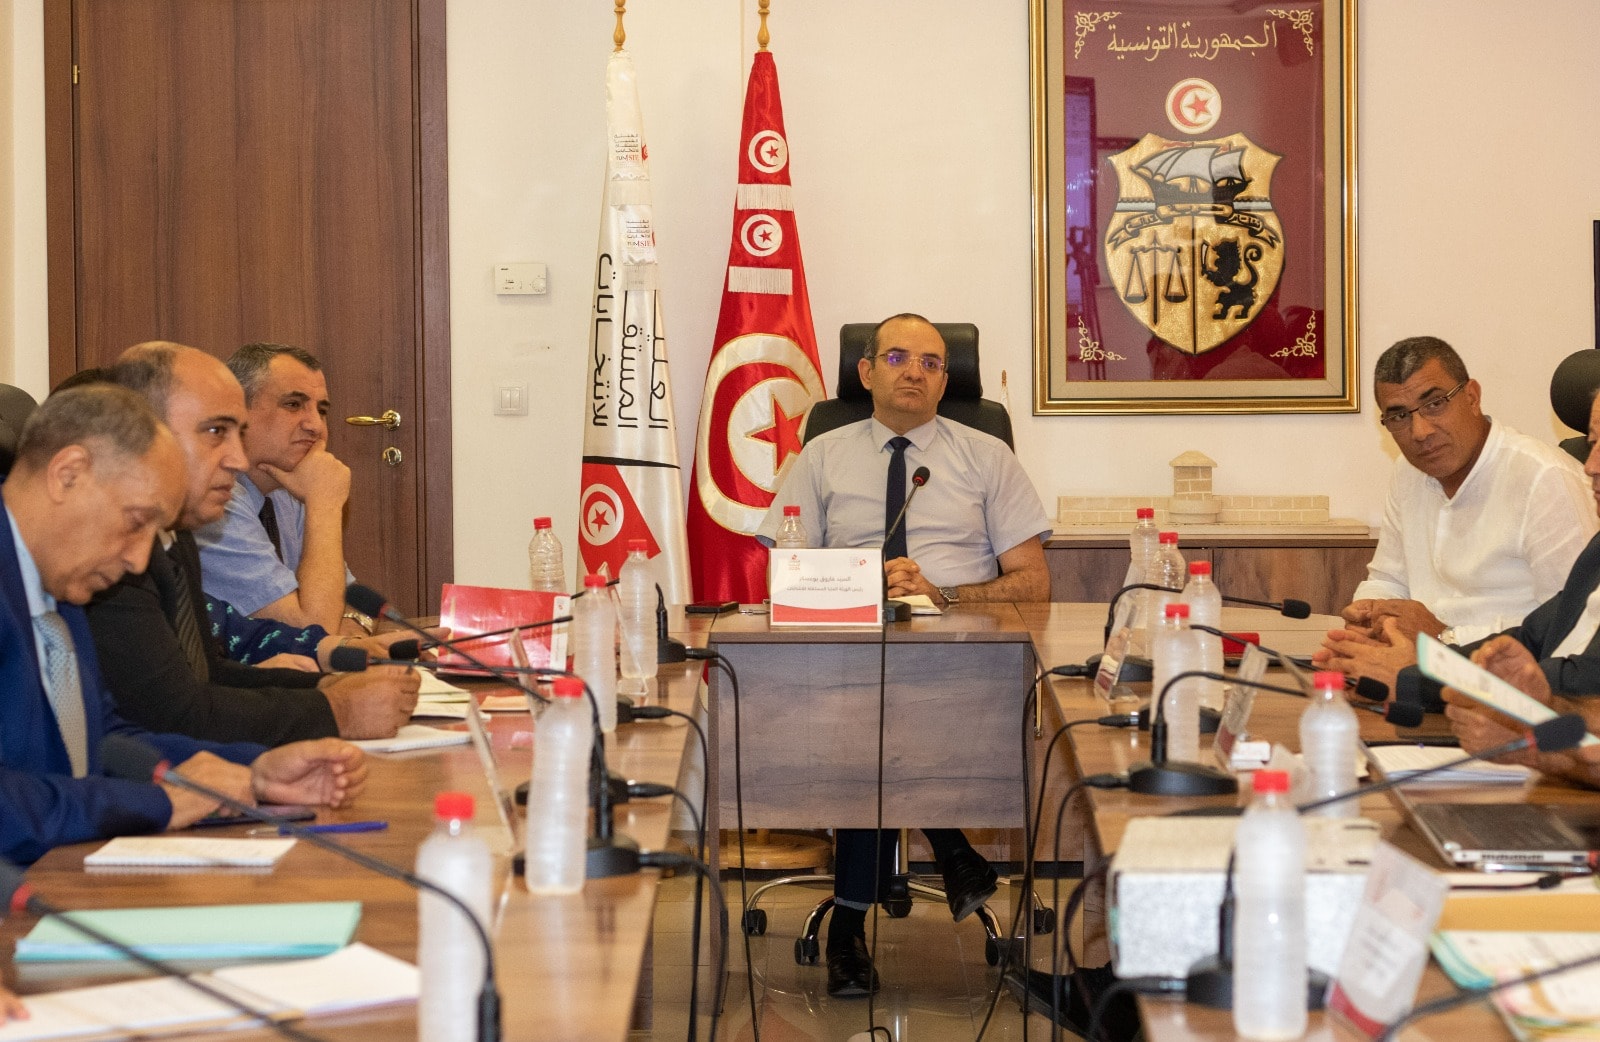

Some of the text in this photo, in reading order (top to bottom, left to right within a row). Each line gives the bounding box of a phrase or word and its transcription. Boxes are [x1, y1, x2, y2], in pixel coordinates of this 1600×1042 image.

[1107, 20, 1278, 62] الجمهورية التونسية
[592, 253, 616, 427] للانتخابات
[617, 289, 643, 428] المستق
[647, 289, 669, 429] العلي
